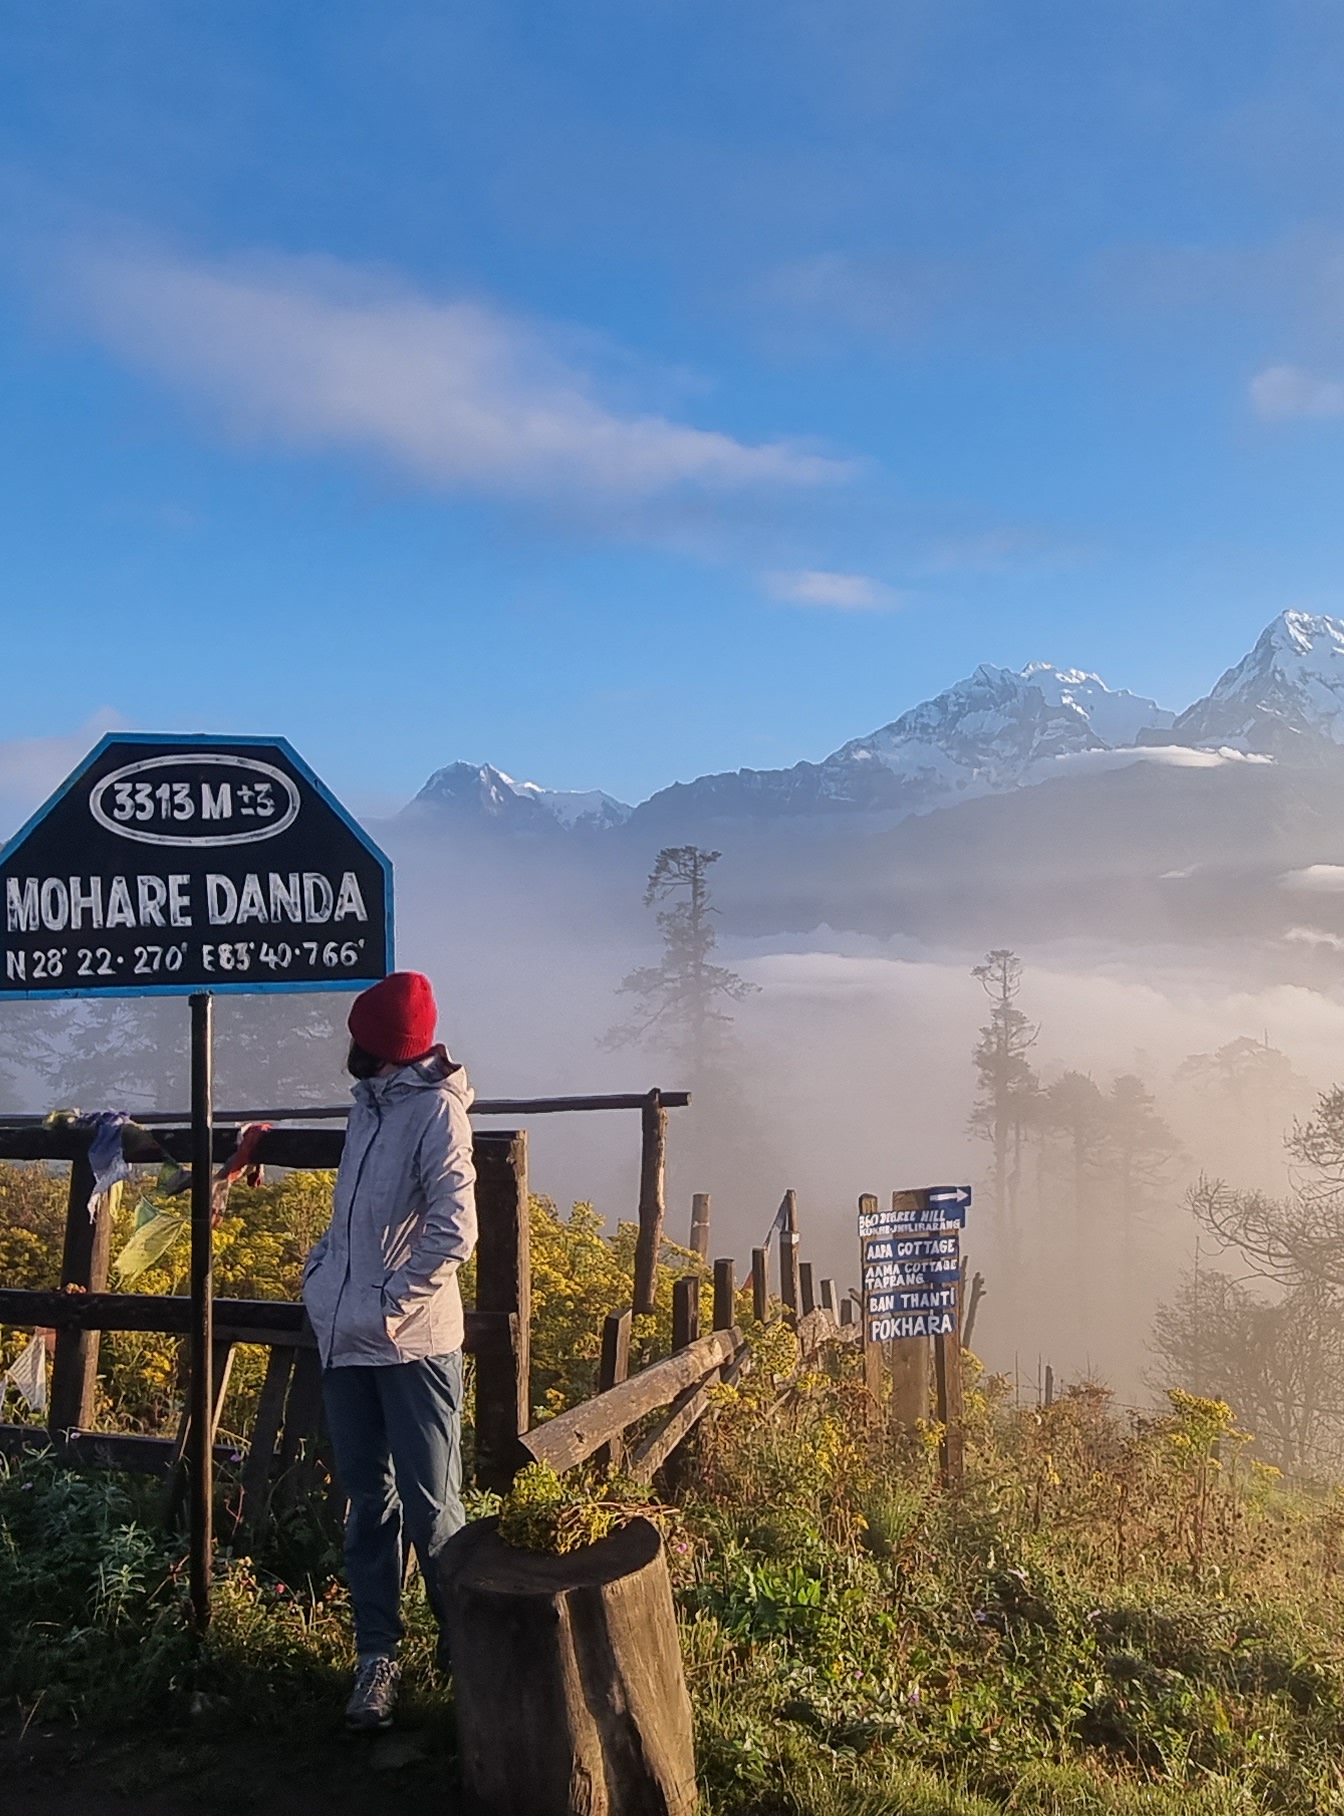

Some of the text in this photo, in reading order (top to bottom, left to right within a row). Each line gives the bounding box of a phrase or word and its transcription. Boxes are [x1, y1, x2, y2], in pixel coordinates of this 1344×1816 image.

[113, 783, 195, 821] 3313
[201, 783, 232, 819] M
[6, 872, 369, 932] MOHARE DANDA
[859, 1214, 879, 1229] 360
[920, 1210, 946, 1222] HILL
[867, 1239, 956, 1260] AAPA COTTAGE
[865, 1260, 958, 1279] AAMA COTTAGE
[864, 1273, 925, 1290] TAPRANG
[869, 1288, 955, 1313] BAN THANTI
[872, 1314, 953, 1341] POKHARA
